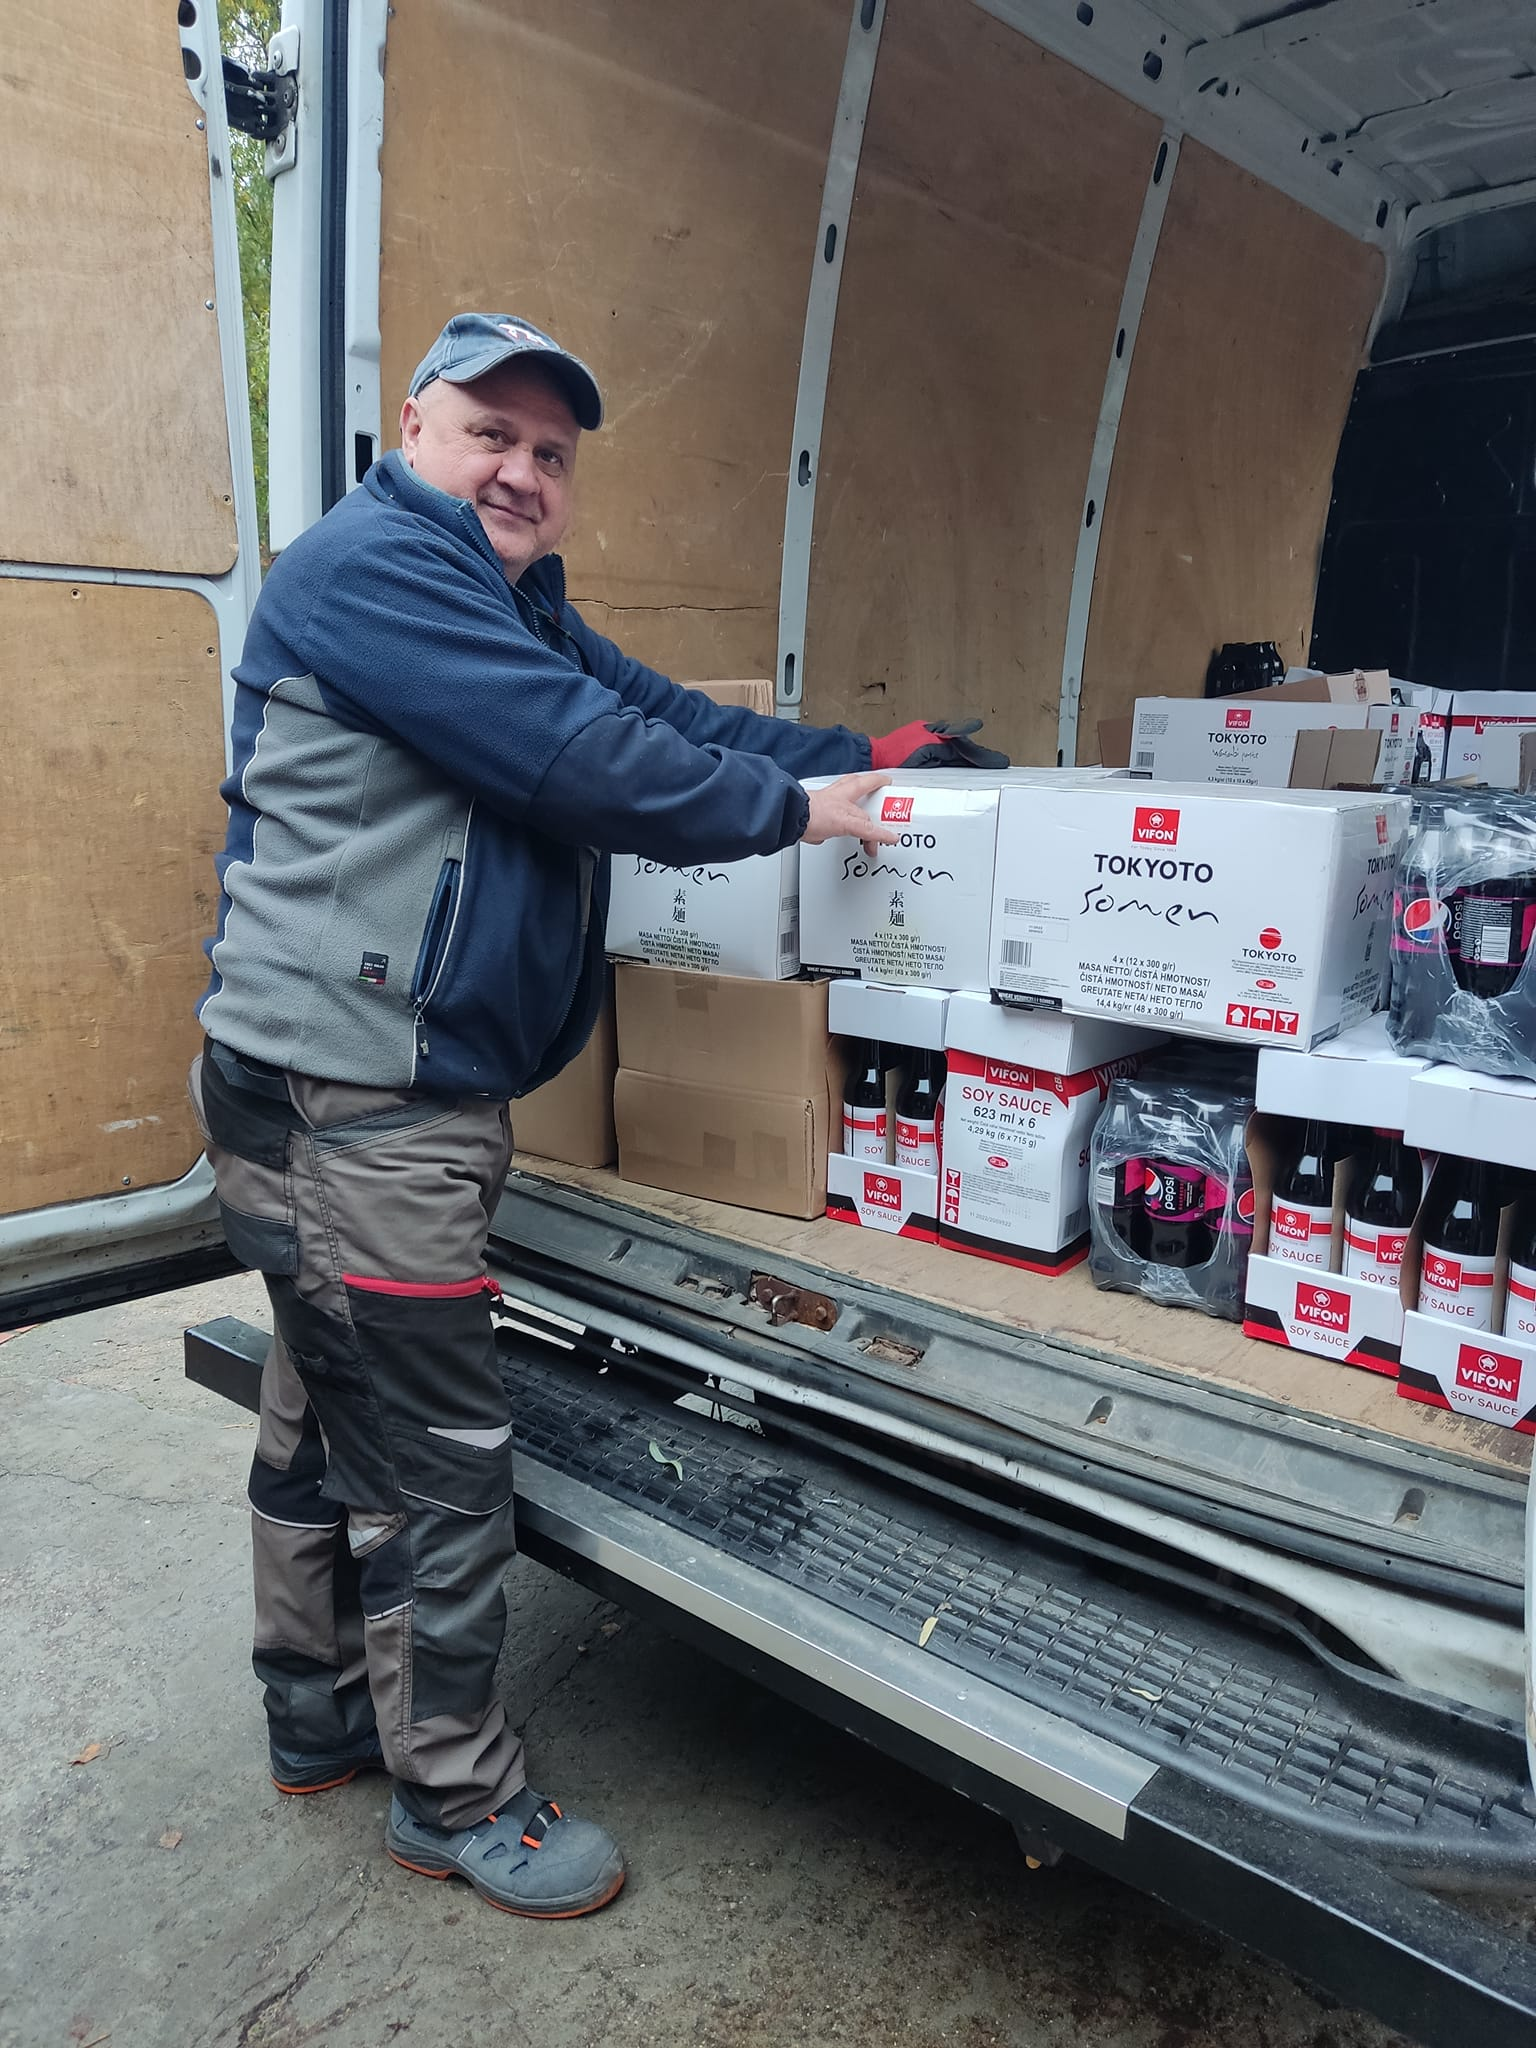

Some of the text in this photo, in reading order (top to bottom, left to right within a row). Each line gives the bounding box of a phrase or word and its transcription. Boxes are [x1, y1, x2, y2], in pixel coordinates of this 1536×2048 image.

[1208, 732, 1267, 745] TOKYOTO
[1463, 753, 1481, 761] SO
[884, 810, 909, 820] VIFON
[1137, 828, 1174, 841] VIFON
[842, 851, 954, 886] Somen
[1094, 853, 1213, 883] TOKYOTO
[1079, 883, 1219, 927] Somen
[1453, 900, 1464, 940] pepsi
[638, 931, 652, 941] MASA
[654, 933, 672, 943] NETTO/
[850, 938, 867, 946] MASA
[868, 940, 890, 949] NETTO/
[890, 941, 909, 950] ČISTÁ
[884, 932, 893, 941] (12
[899, 934, 909, 942] 300
[642, 947, 671, 959] GREUTATE
[687, 946, 702, 955] NETO
[852, 946, 870, 955] ČISTÁ
[907, 951, 924, 960] NETO
[925, 953, 946, 962] MASA/
[1242, 948, 1297, 963] TOKYOTO
[854, 956, 886, 966] GREUTATE
[1112, 955, 1118, 963] 4
[1125, 956, 1138, 967] (12
[1146, 959, 1160, 969] 300
[867, 966, 879, 974] 14,4
[910, 970, 920, 978] 300
[1079, 962, 1211, 988] MASA NETTO/ ČISTÁ HMOTNOST/
[1079, 971, 1103, 983] ČISTÁ
[1105, 976, 1153, 991] HMOTNOSŤ/
[1155, 983, 1178, 995] NETO
[1180, 987, 1207, 999] MASA/
[1080, 985, 1148, 1002] GREUTATE NETA/
[1096, 998, 1111, 1009] 14,4
[1133, 1004, 1145, 1015] (48
[1154, 1007, 1168, 1017] 300
[990, 1066, 1029, 1084] VIFON
[962, 1087, 1052, 1116] SOY SAUCE
[974, 1106, 1036, 1128] 623 ml x 6
[968, 1125, 984, 1135] 4,29
[986, 1128, 995, 1139] kg
[998, 1131, 1005, 1140] (6
[1013, 1135, 1027, 1145] 715
[1028, 1139, 1037, 1149] g)
[864, 1146, 884, 1154] SOY
[901, 1154, 930, 1167] SAUCE
[866, 1189, 898, 1204] VIFON
[1164, 1175, 1176, 1211] pepsi
[861, 1207, 903, 1223] SOY SAUCE
[1277, 1223, 1307, 1238] VIFON
[1270, 1242, 1323, 1263] OY SAUCE
[1360, 1271, 1385, 1285] SOY
[1426, 1270, 1456, 1288] VIFON
[1419, 1291, 1475, 1317] OY SAUCE
[1298, 1303, 1344, 1325] VIFON
[1518, 1319, 1536, 1333] SO
[1289, 1325, 1350, 1348] SOY SAUCE
[1461, 1367, 1512, 1393] VIFON
[1450, 1390, 1519, 1417] SOY SAUCE
